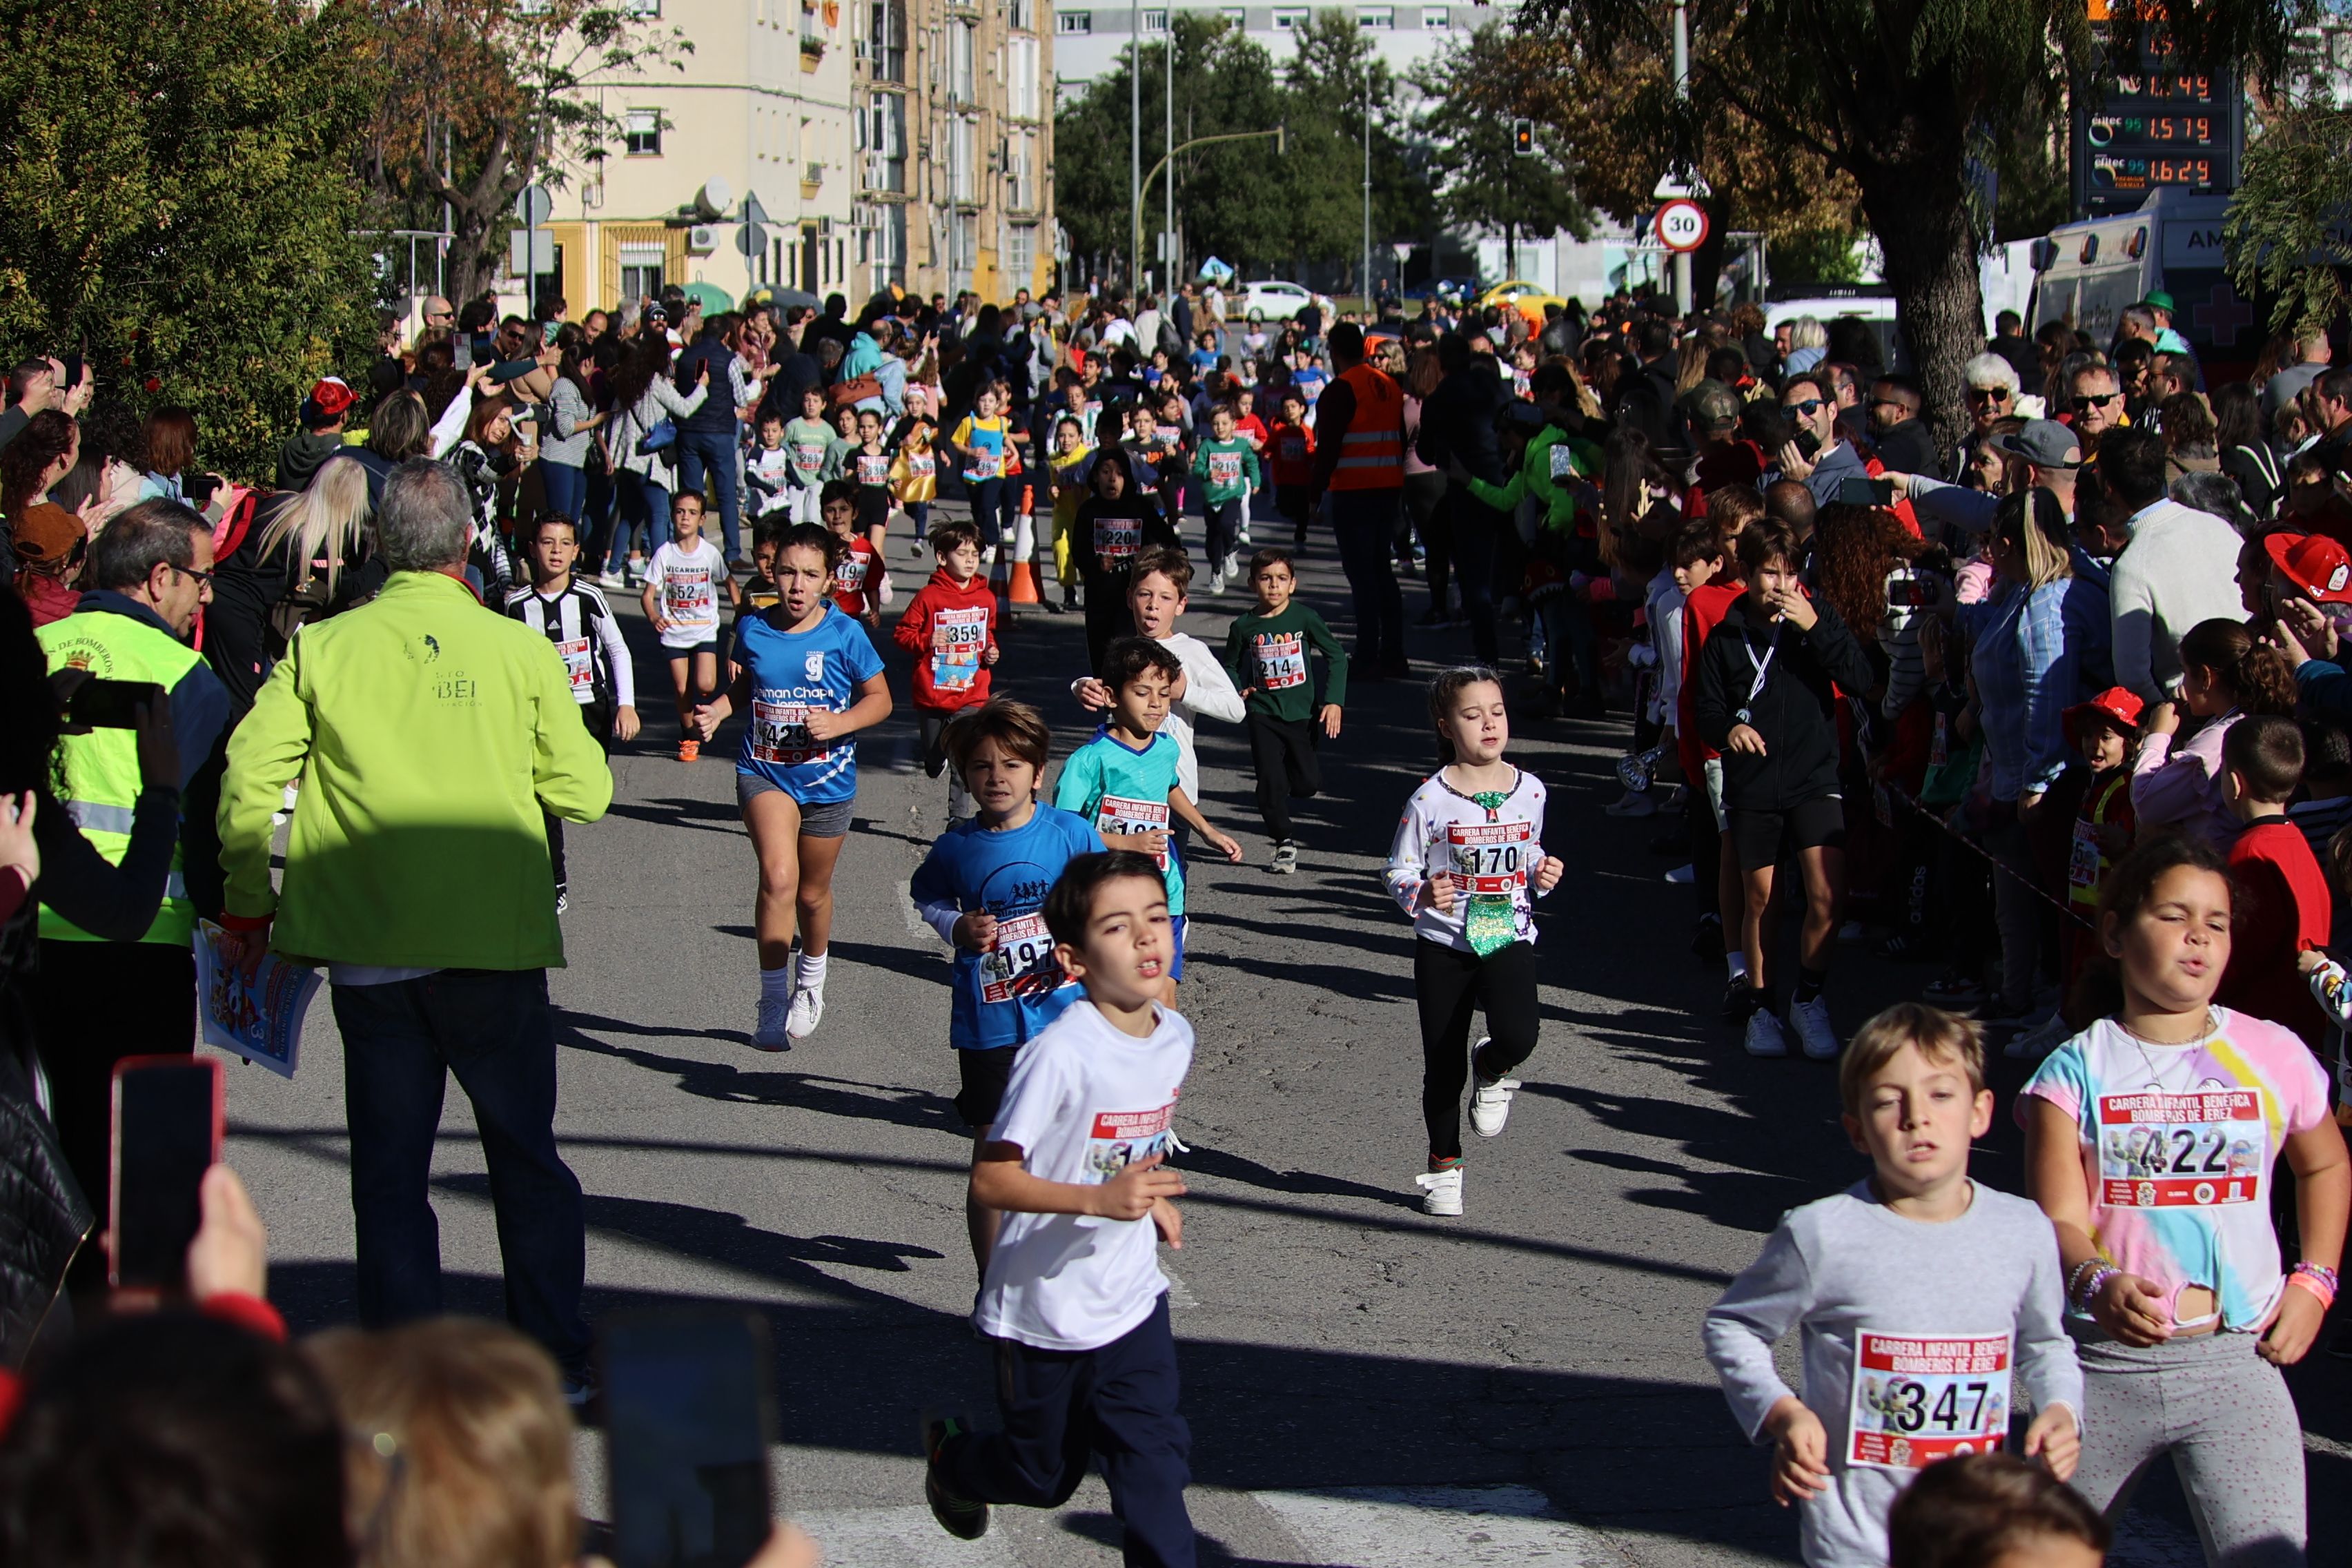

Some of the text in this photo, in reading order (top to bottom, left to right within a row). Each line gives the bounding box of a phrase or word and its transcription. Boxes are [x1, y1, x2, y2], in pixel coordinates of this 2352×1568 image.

[2126, 118, 2142, 133] 95
[2128, 159, 2145, 174] 95
[1670, 217, 1695, 233] 30
[801, 454, 819, 462] 263
[1218, 461, 1236, 471] 212
[1106, 531, 1132, 545] 220
[677, 585, 695, 599] 52
[950, 625, 979, 643] 359
[1260, 658, 1291, 677] 214
[766, 725, 810, 747] 429
[1105, 798, 1131, 811] CARRERA
[1131, 803, 1153, 814] INFANTIL
[1115, 809, 1144, 820] BOMBEROS
[1145, 812, 1152, 821] DE
[1452, 823, 1529, 837] CARRERA INFANTIL BENÉFICA
[1464, 832, 1521, 845] BOMBEROS DE JEREZ
[1470, 846, 1518, 874] 170
[1007, 919, 1036, 933] INFANTIL
[1026, 927, 1037, 938] DE
[1000, 938, 1053, 976] 197
[2108, 1092, 2251, 1111] CARRERA INFANTIL BENÉFICA
[1101, 1114, 1139, 1127] CARRERA
[2130, 1106, 2233, 1124] BOMBEROS DE JEREZ
[2139, 1128, 2227, 1173] 422
[1870, 1337, 1924, 1357] CARRERA
[1925, 1342, 1972, 1358] INFANTIL
[1892, 1355, 1998, 1373] BOMBEROS DE JEREZ
[1898, 1382, 1989, 1431] 347
